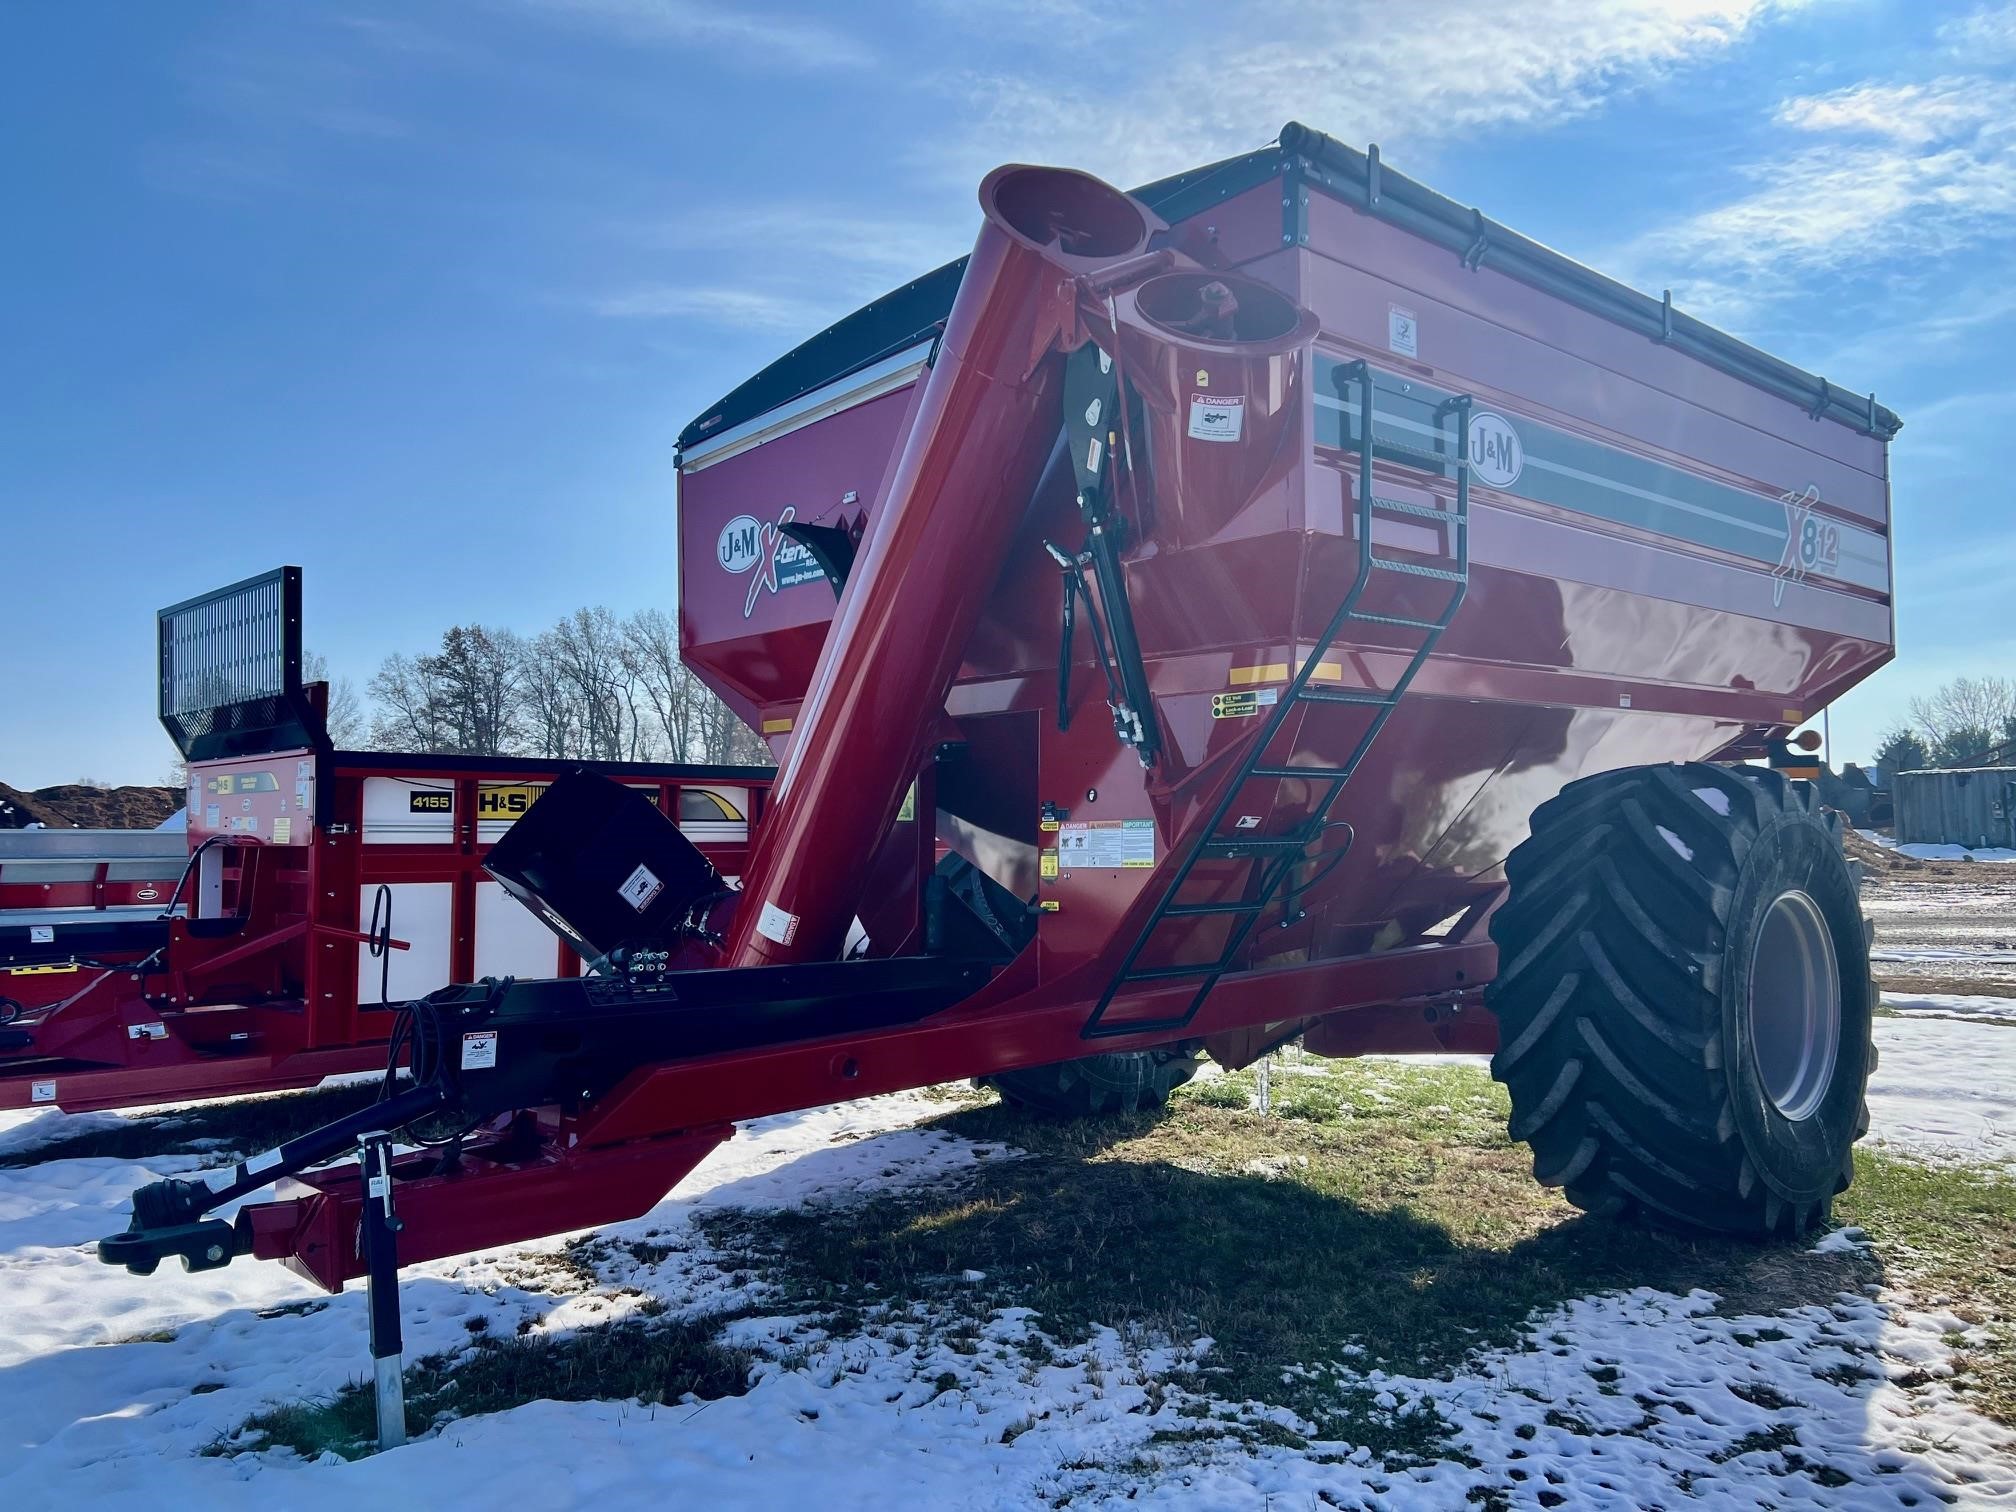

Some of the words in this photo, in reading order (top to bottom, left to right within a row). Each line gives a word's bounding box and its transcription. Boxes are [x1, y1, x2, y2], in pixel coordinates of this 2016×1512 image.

[1471, 427, 1514, 474] J&M
[722, 525, 756, 563] J&M
[412, 796, 449, 808] 4155
[479, 793, 527, 813] H&S
[1122, 821, 1154, 829] IMPORTANT
